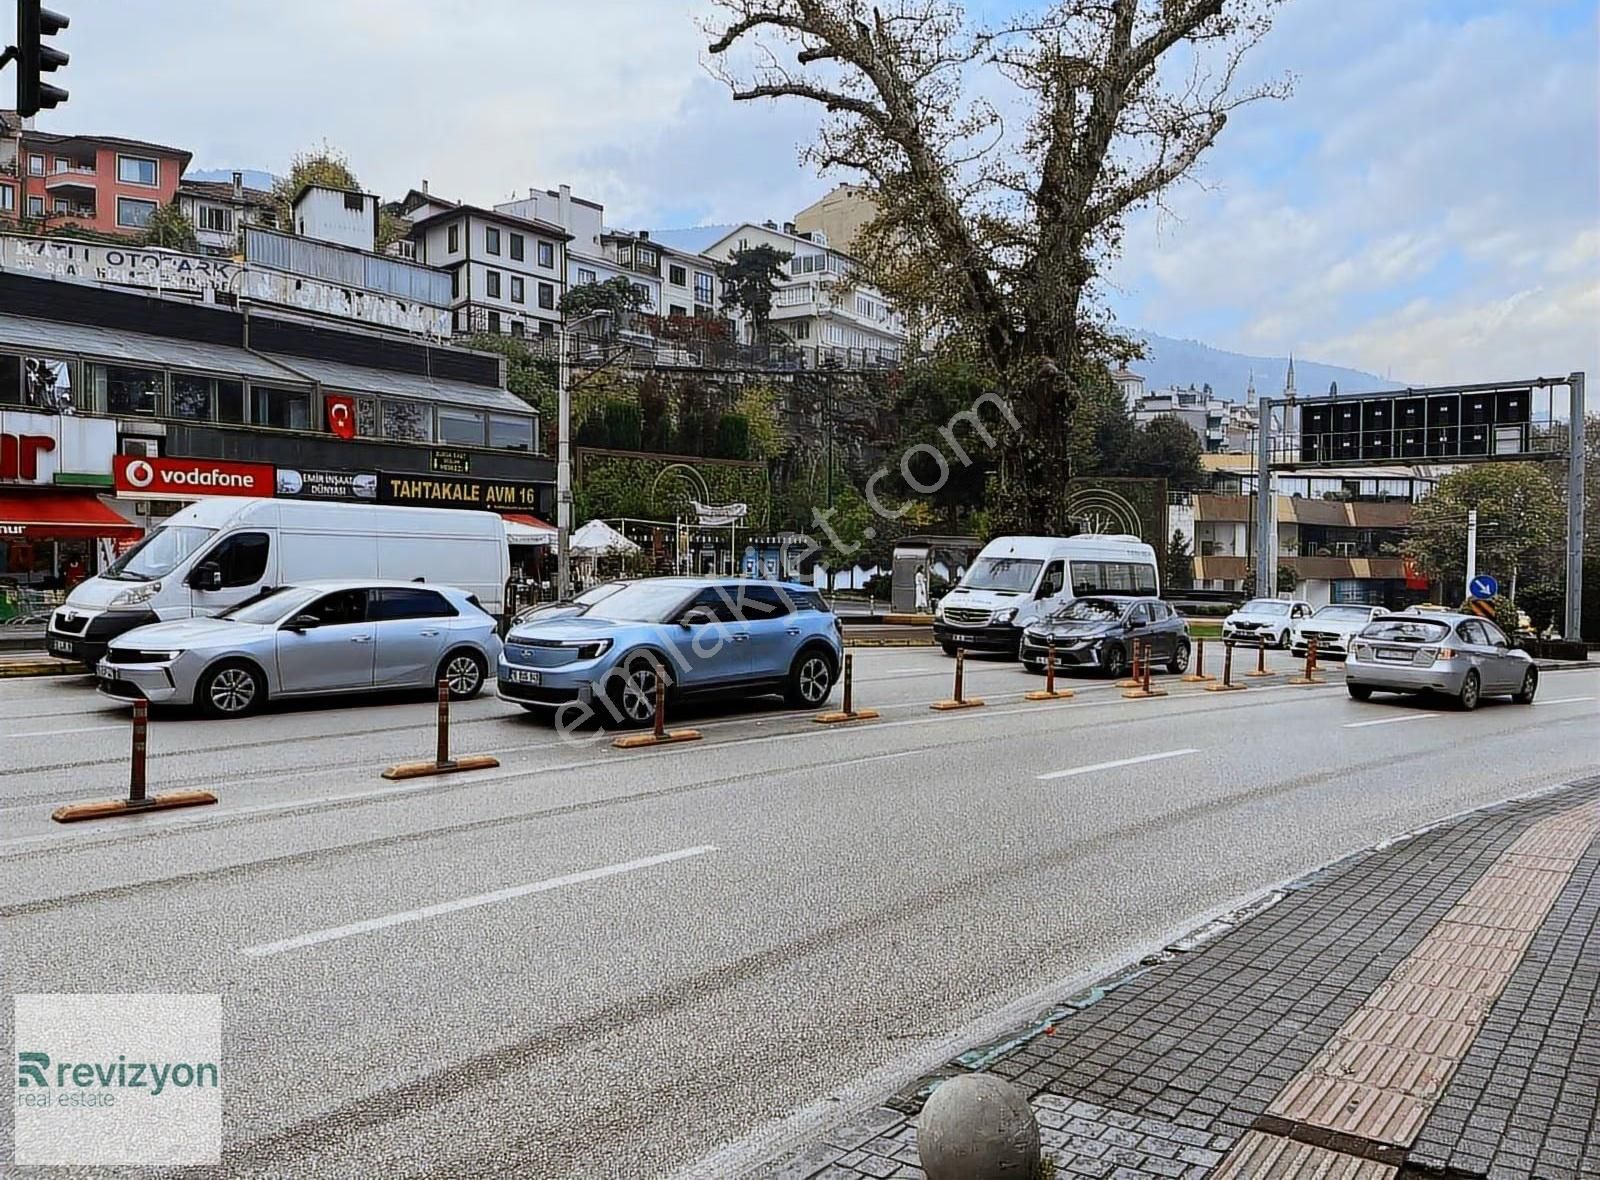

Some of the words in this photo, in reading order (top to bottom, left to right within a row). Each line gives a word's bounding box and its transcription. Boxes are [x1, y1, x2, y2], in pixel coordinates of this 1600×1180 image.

[160, 469, 254, 488] vodafone
[390, 479, 480, 501] TAHTAKALE
[486, 485, 515, 503] AVM
[519, 487, 535, 504] 16
